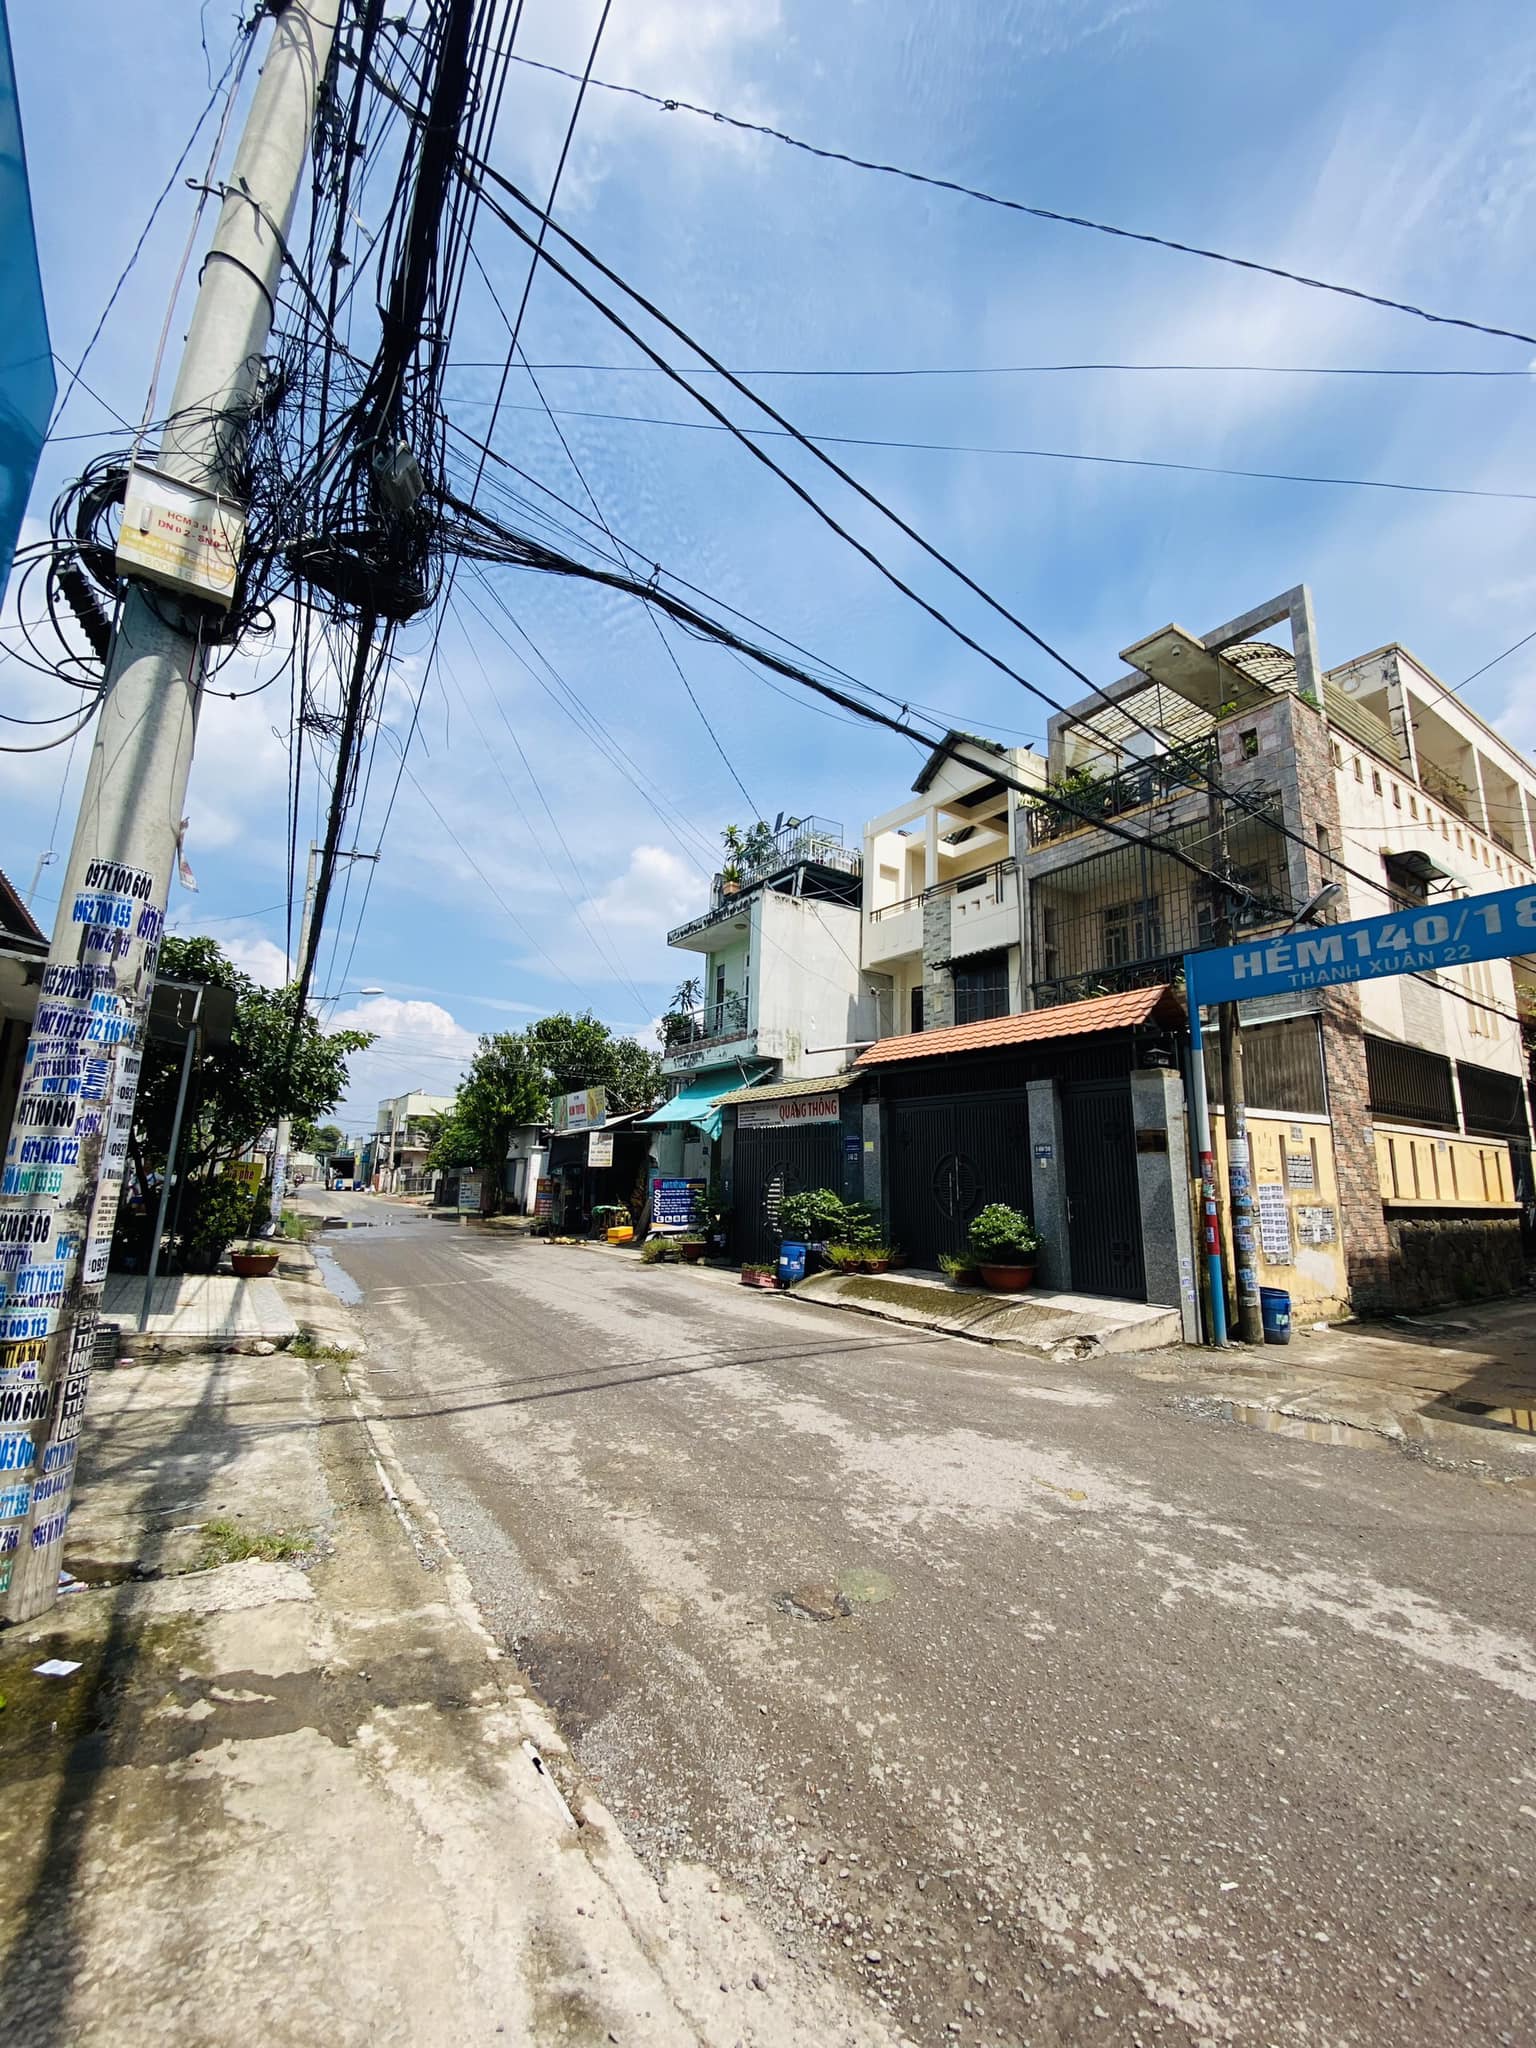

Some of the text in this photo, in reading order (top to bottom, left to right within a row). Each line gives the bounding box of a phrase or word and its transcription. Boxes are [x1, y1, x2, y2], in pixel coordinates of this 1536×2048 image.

[1288, 945, 1472, 987] THANH XUÂN 22
